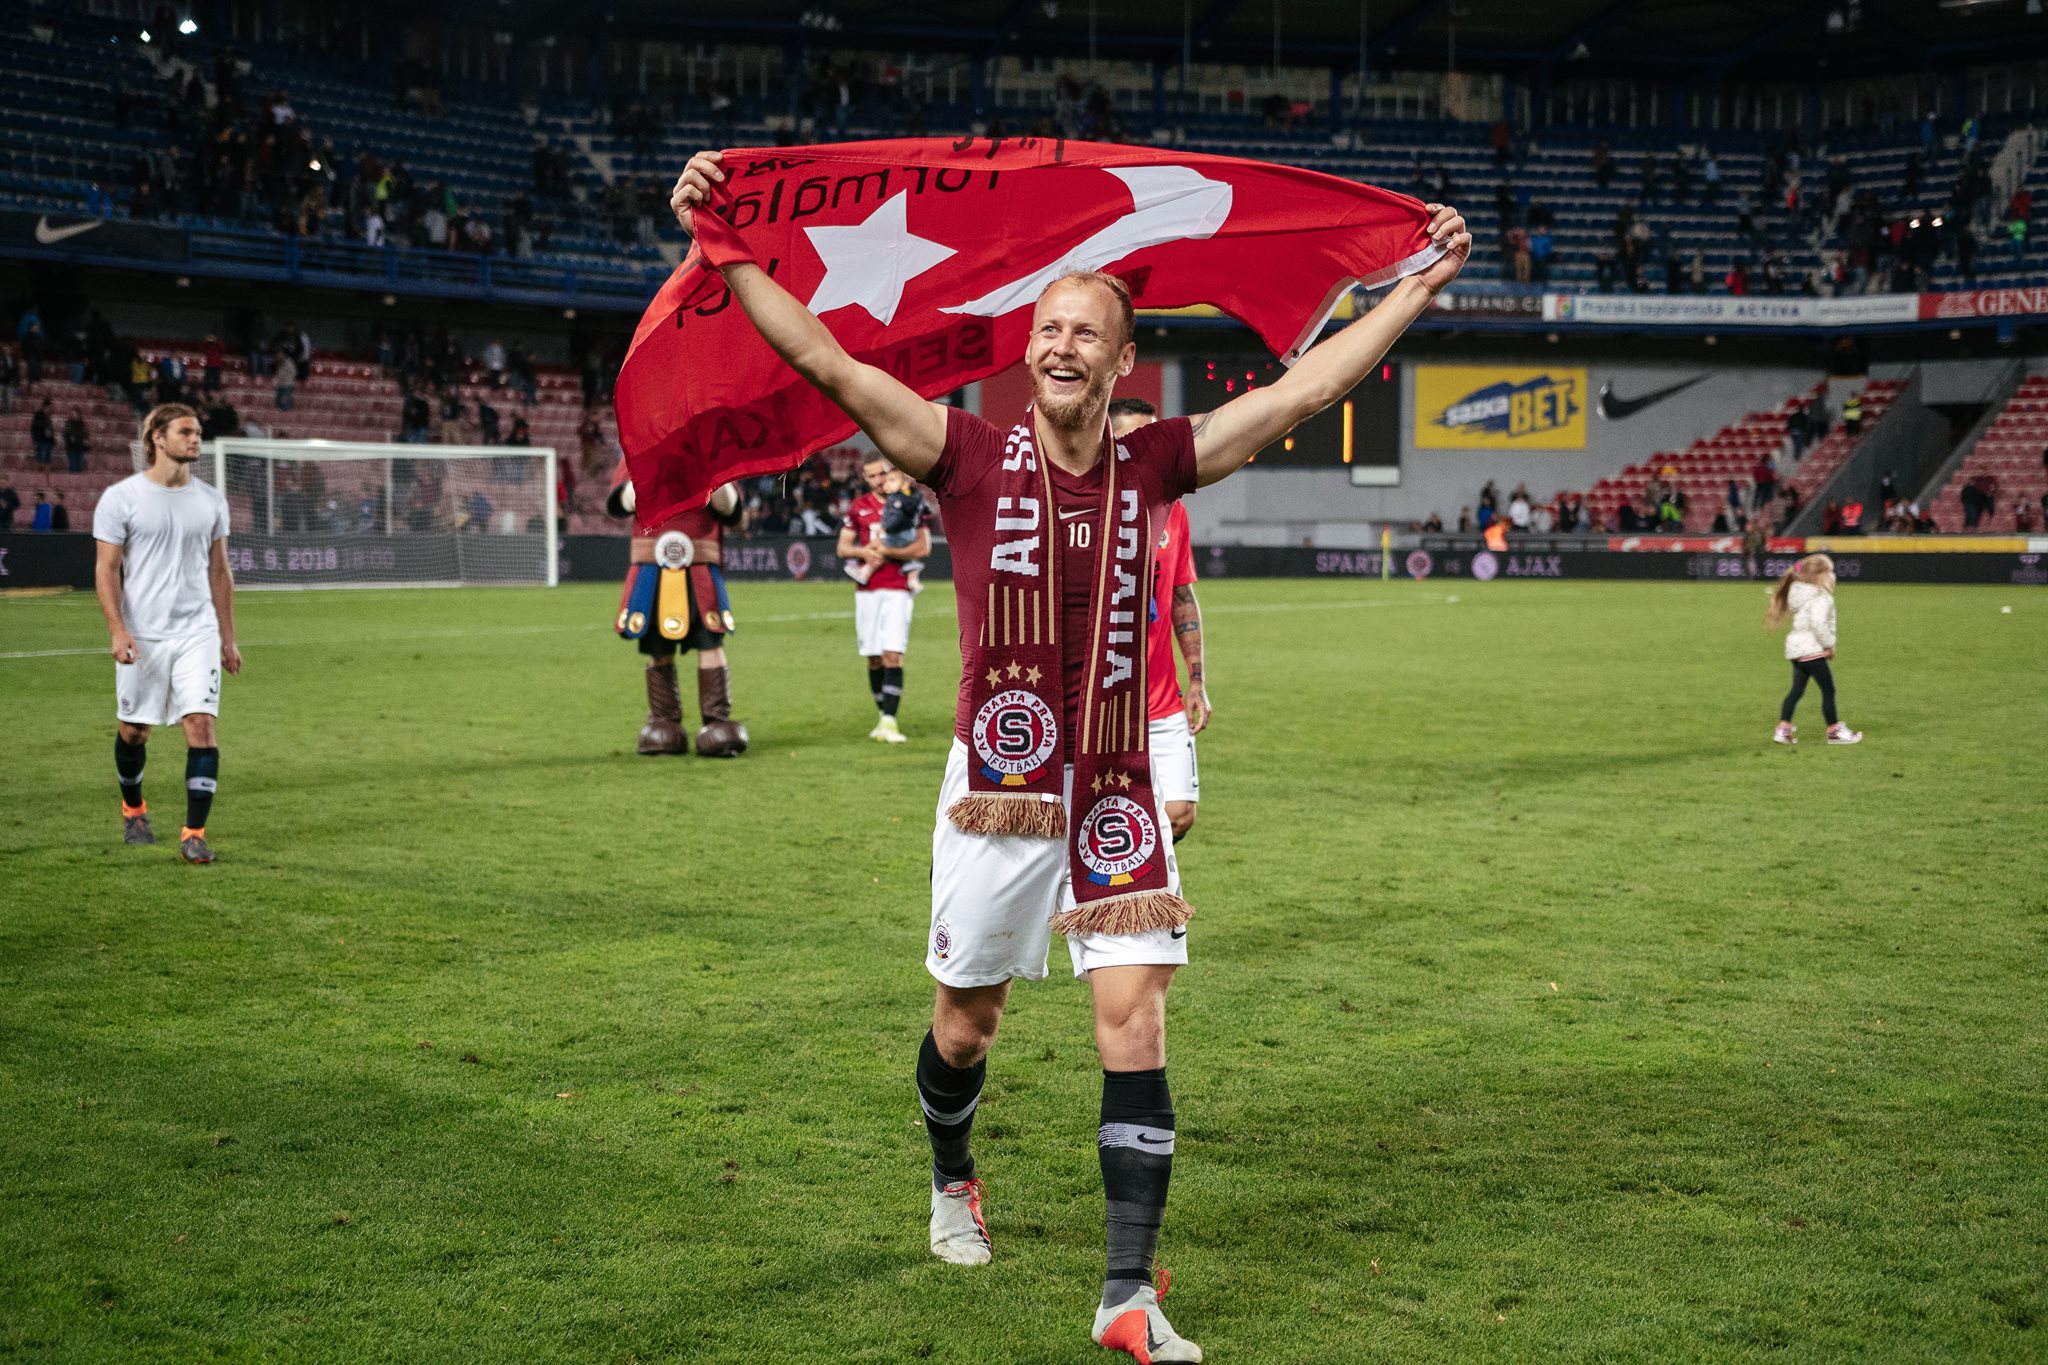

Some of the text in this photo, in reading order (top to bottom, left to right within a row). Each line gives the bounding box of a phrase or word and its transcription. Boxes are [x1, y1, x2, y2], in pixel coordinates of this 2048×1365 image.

[1509, 382, 1574, 435] BET
[990, 496, 1040, 578] AC
[1067, 521, 1091, 549] 10
[287, 546, 337, 571] 2018
[1316, 552, 1397, 573] SPARTA
[1505, 556, 1562, 577] AJAX
[978, 690, 1026, 724] SPARTA
[1030, 699, 1056, 748] PRAHA
[997, 709, 1032, 755] S
[989, 756, 1040, 773] FOTBAL
[1082, 797, 1119, 834] SPARTA
[1124, 802, 1155, 846] PRAHA
[1096, 813, 1134, 857] S
[1095, 855, 1143, 873] FOTBAL
